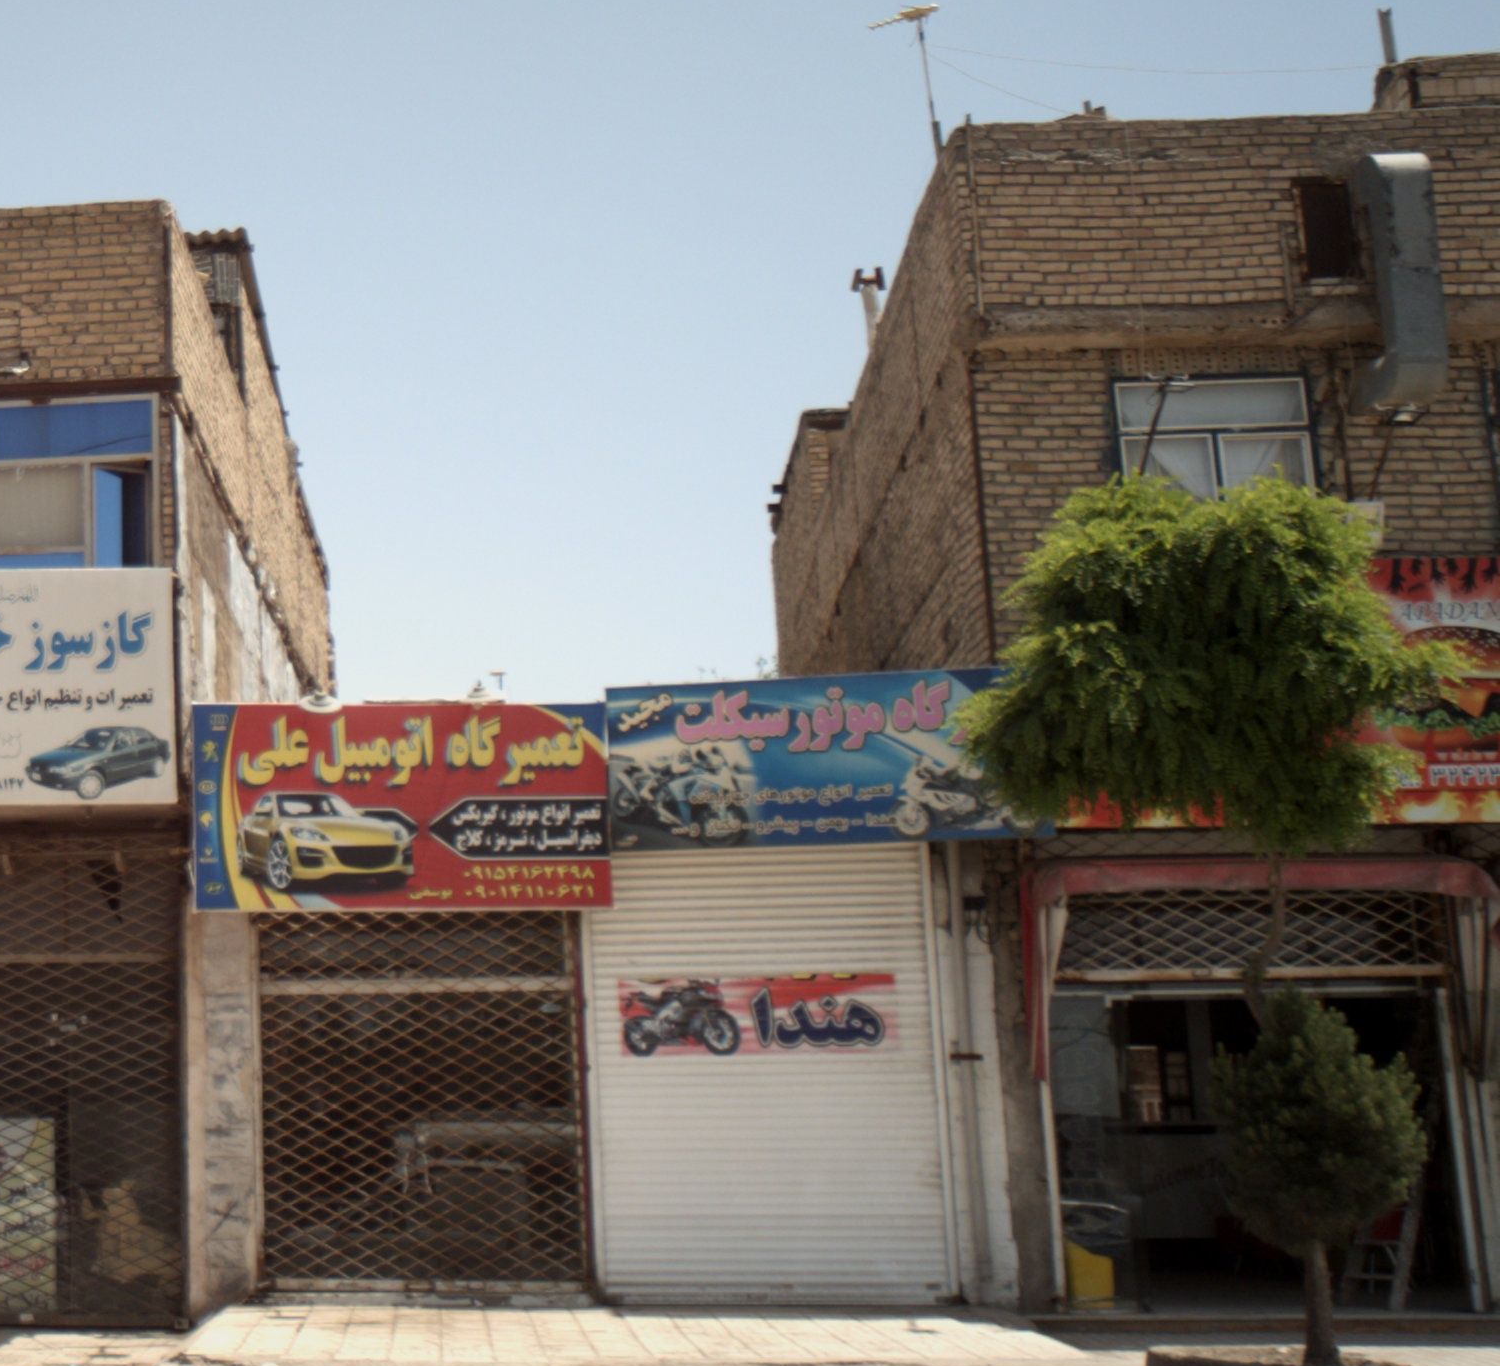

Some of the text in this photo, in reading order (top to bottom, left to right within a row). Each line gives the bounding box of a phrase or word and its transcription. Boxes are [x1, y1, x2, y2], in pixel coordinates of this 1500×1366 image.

[6, 688, 41, 711] انواع
[44, 688, 83, 709] تنظیم
[85, 697, 93, 711] و
[891, 680, 950, 732] گاه
[237, 715, 584, 788] تعمیر گاه اتومبیل علی
[542, 803, 570, 826] انواع
[572, 803, 601, 826] تعمیر
[750, 985, 885, 1049] هندا
